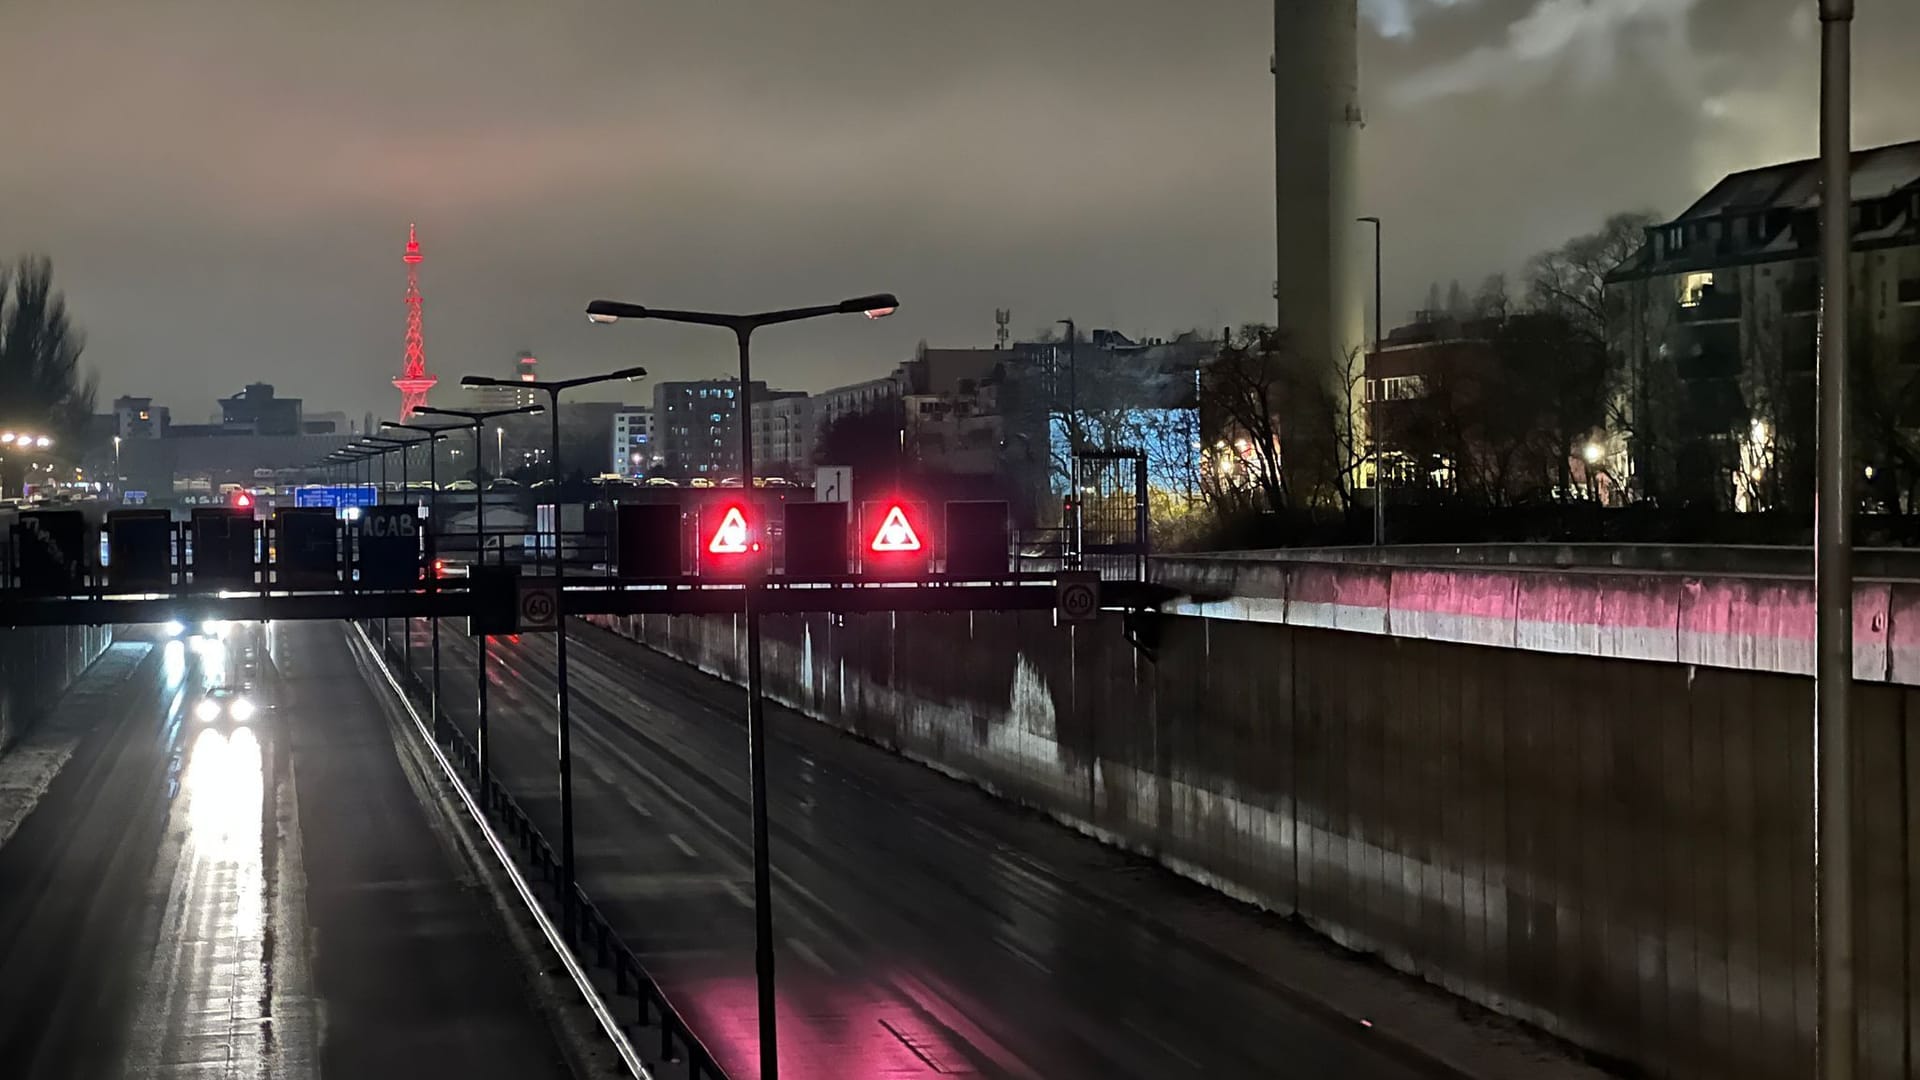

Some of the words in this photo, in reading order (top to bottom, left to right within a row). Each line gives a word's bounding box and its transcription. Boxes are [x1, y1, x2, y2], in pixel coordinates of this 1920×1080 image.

[363, 513, 416, 537] ACAB
[530, 600, 548, 614] 60
[1069, 593, 1088, 608] 60
